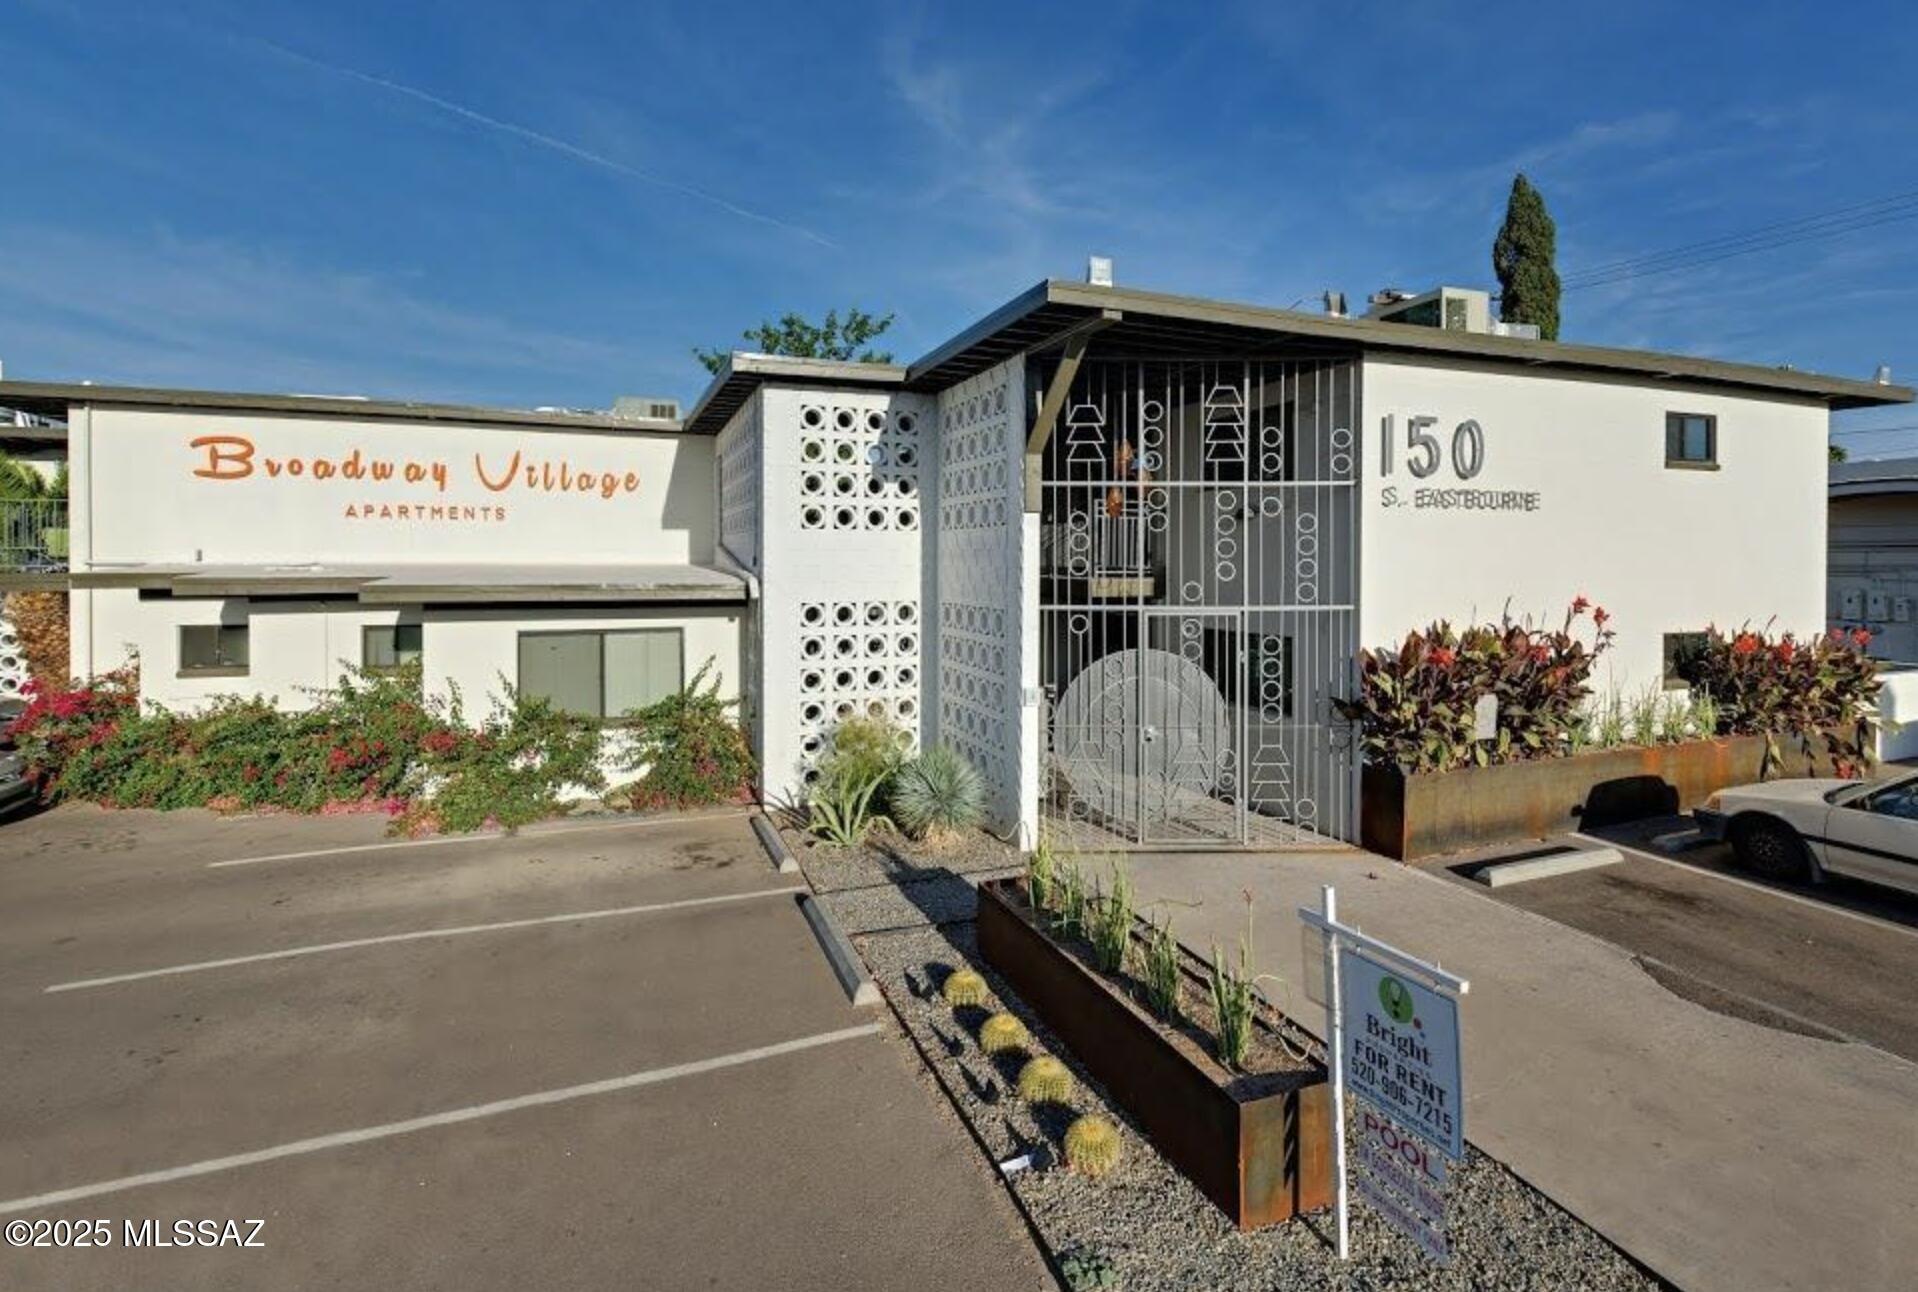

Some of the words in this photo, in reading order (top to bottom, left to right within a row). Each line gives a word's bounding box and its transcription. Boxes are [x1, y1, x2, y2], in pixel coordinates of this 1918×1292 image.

[190, 436, 448, 491] Broadway
[475, 449, 640, 499] Village
[1380, 414, 1485, 480] 150
[345, 504, 507, 521] APARTMENTS
[1415, 488, 1541, 511] EASTBOURNE
[1366, 1012, 1432, 1067] Bright
[1351, 1056, 1452, 1135] 520-906-7215
[1354, 1039, 1389, 1073] FOR
[1396, 1062, 1447, 1107] RENT
[1365, 1113, 1438, 1181] POOL
